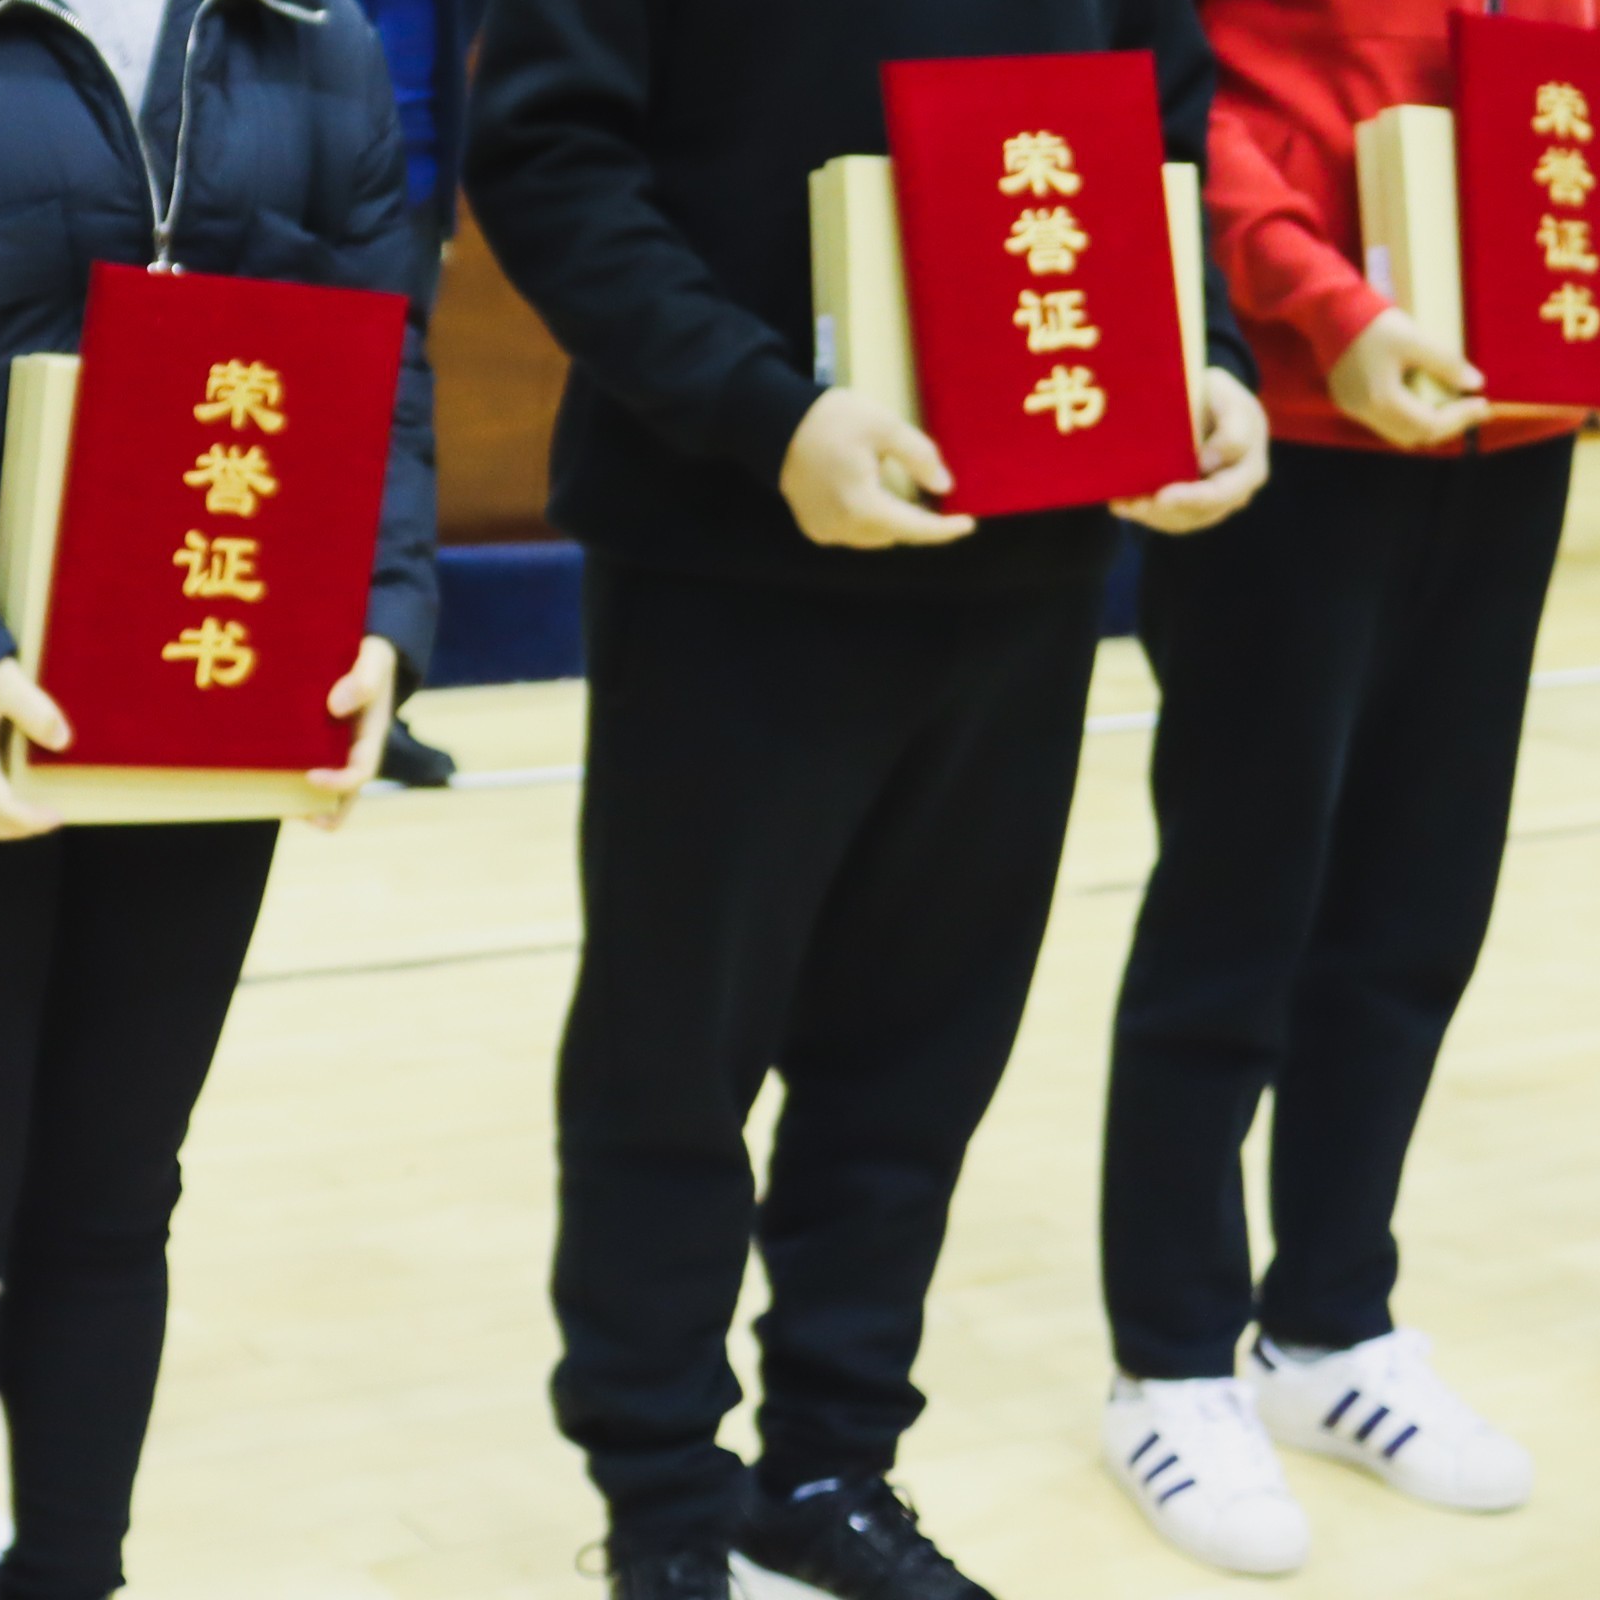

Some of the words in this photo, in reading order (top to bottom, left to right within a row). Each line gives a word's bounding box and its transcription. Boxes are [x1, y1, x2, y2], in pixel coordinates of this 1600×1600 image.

[997, 129, 1108, 435] 荣誉证书
[160, 357, 287, 690] 荣誉证书
